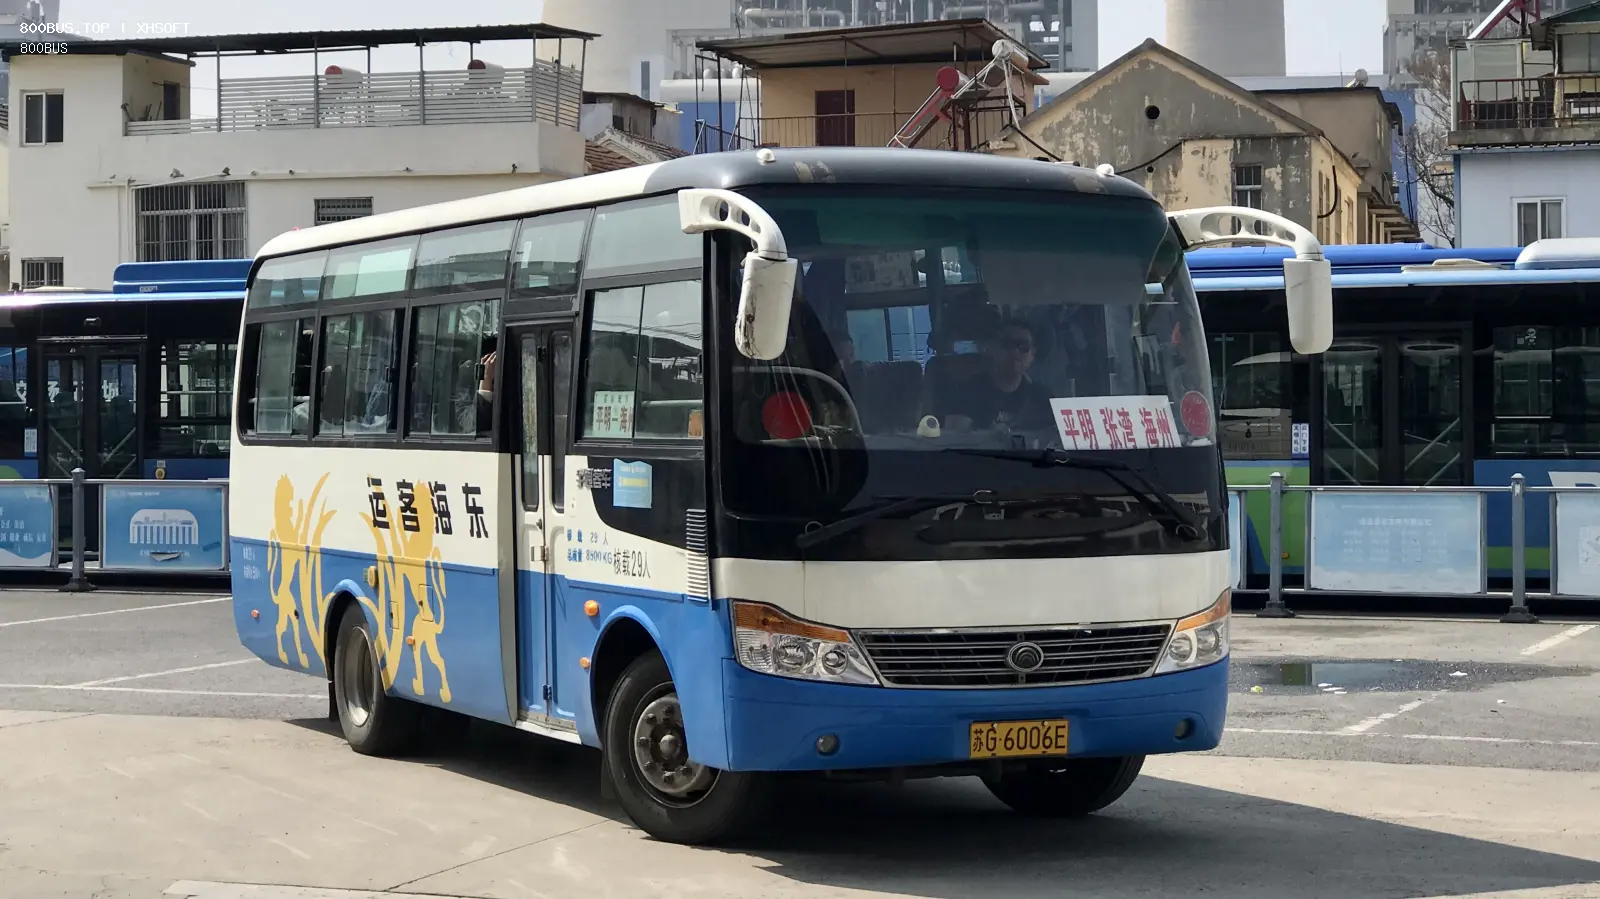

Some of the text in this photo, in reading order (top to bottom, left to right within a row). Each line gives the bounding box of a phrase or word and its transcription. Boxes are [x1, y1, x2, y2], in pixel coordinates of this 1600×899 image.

[1060, 407, 1175, 450] 平明 张湾 海州
